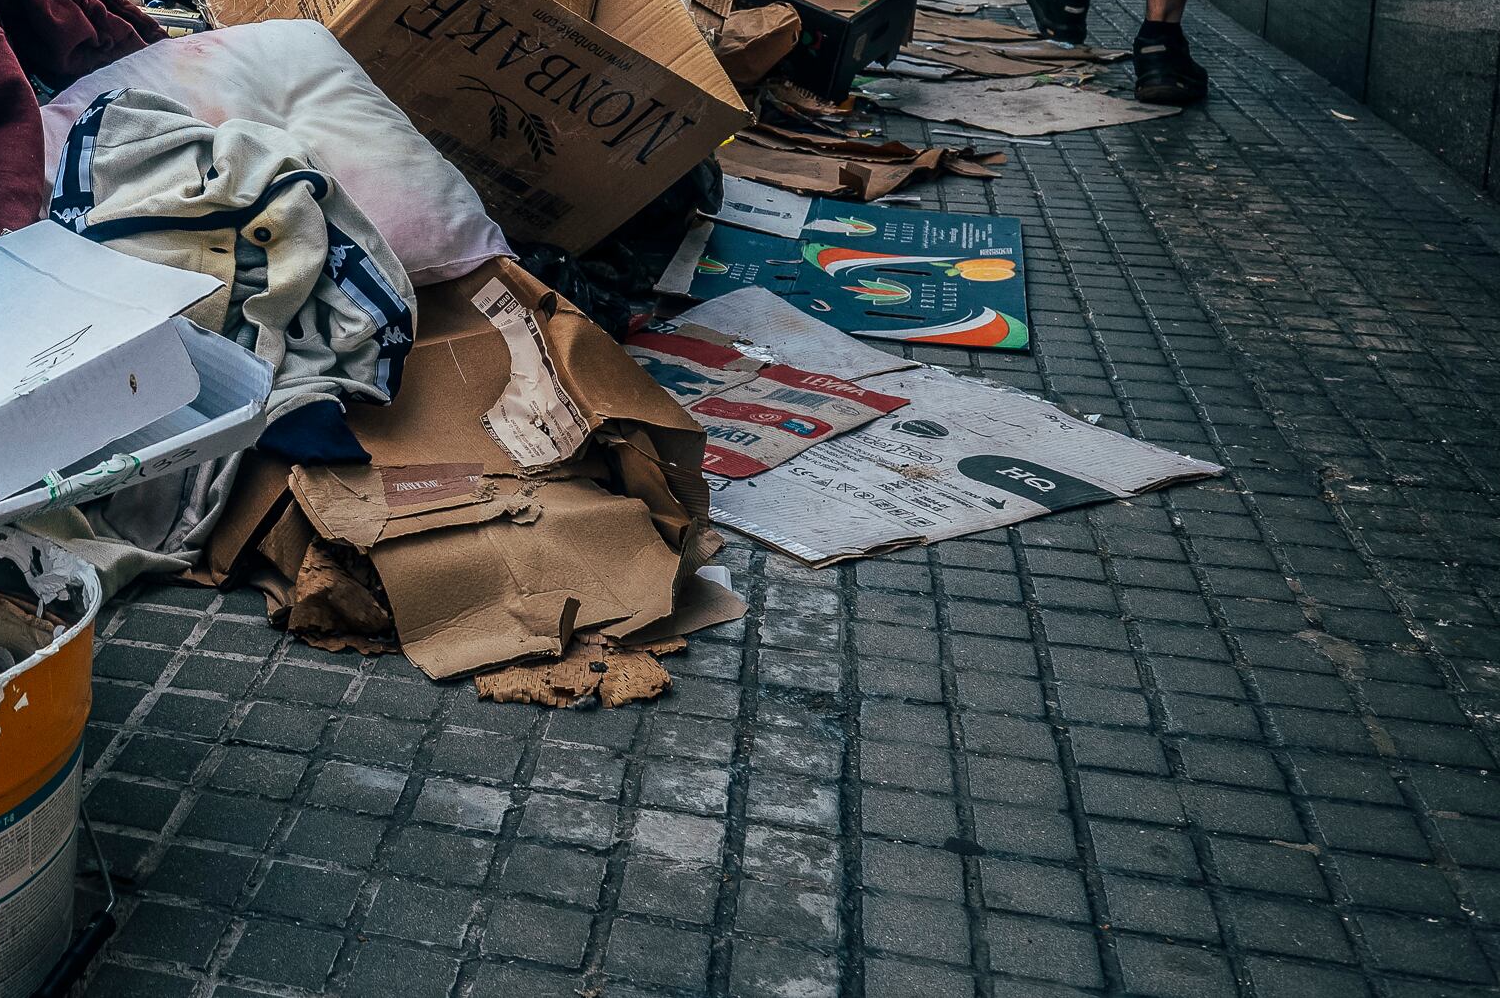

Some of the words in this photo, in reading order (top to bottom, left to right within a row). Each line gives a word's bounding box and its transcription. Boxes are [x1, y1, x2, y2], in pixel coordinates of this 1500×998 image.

[532, 8, 633, 72] www.monbake.com
[497, 293, 510, 309] 01/01
[920, 282, 937, 310] FRUIT
[941, 281, 958, 312] VALLEY
[801, 374, 867, 398] LEYMA
[996, 466, 1057, 493] HQ
